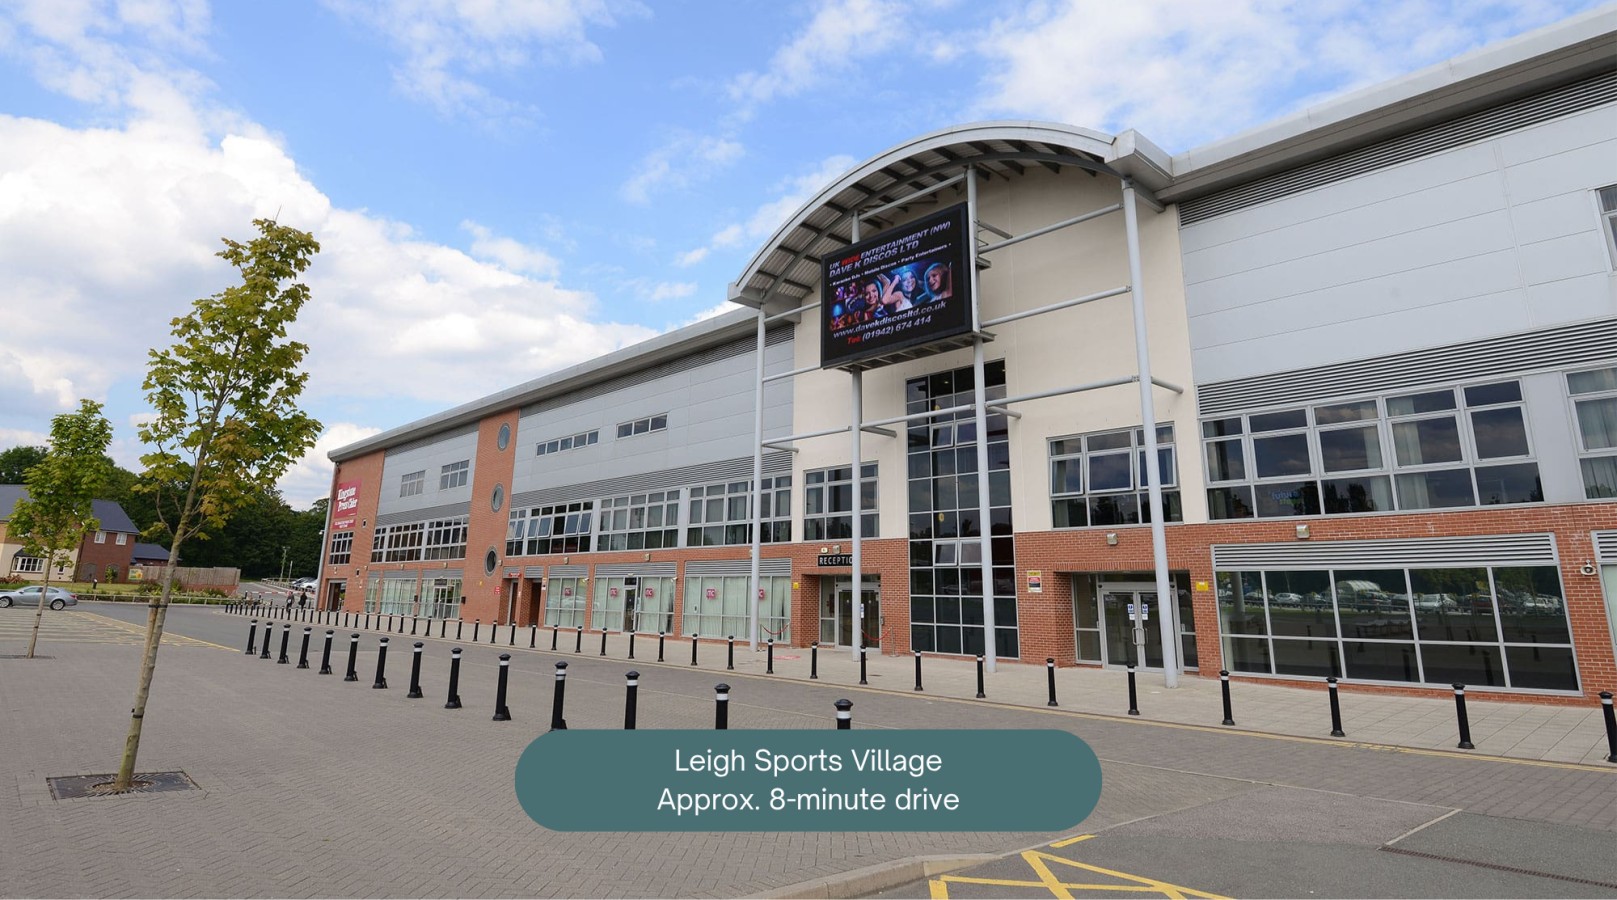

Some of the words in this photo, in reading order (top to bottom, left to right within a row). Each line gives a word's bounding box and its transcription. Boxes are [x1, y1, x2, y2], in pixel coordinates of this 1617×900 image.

[829, 262, 852, 278] DAVE
[854, 260, 861, 269] K
[863, 247, 898, 266] DISCOS
[900, 240, 919, 253] LTD
[860, 229, 928, 259] ENTERTAINMENT
[930, 221, 951, 236] (NW)
[833, 300, 947, 338] www.davekdiscosltd.co.uk
[862, 325, 894, 342] (01942)
[895, 320, 912, 331] 674
[913, 315, 932, 326] 414
[819, 556, 853, 565] RECEPTIO
